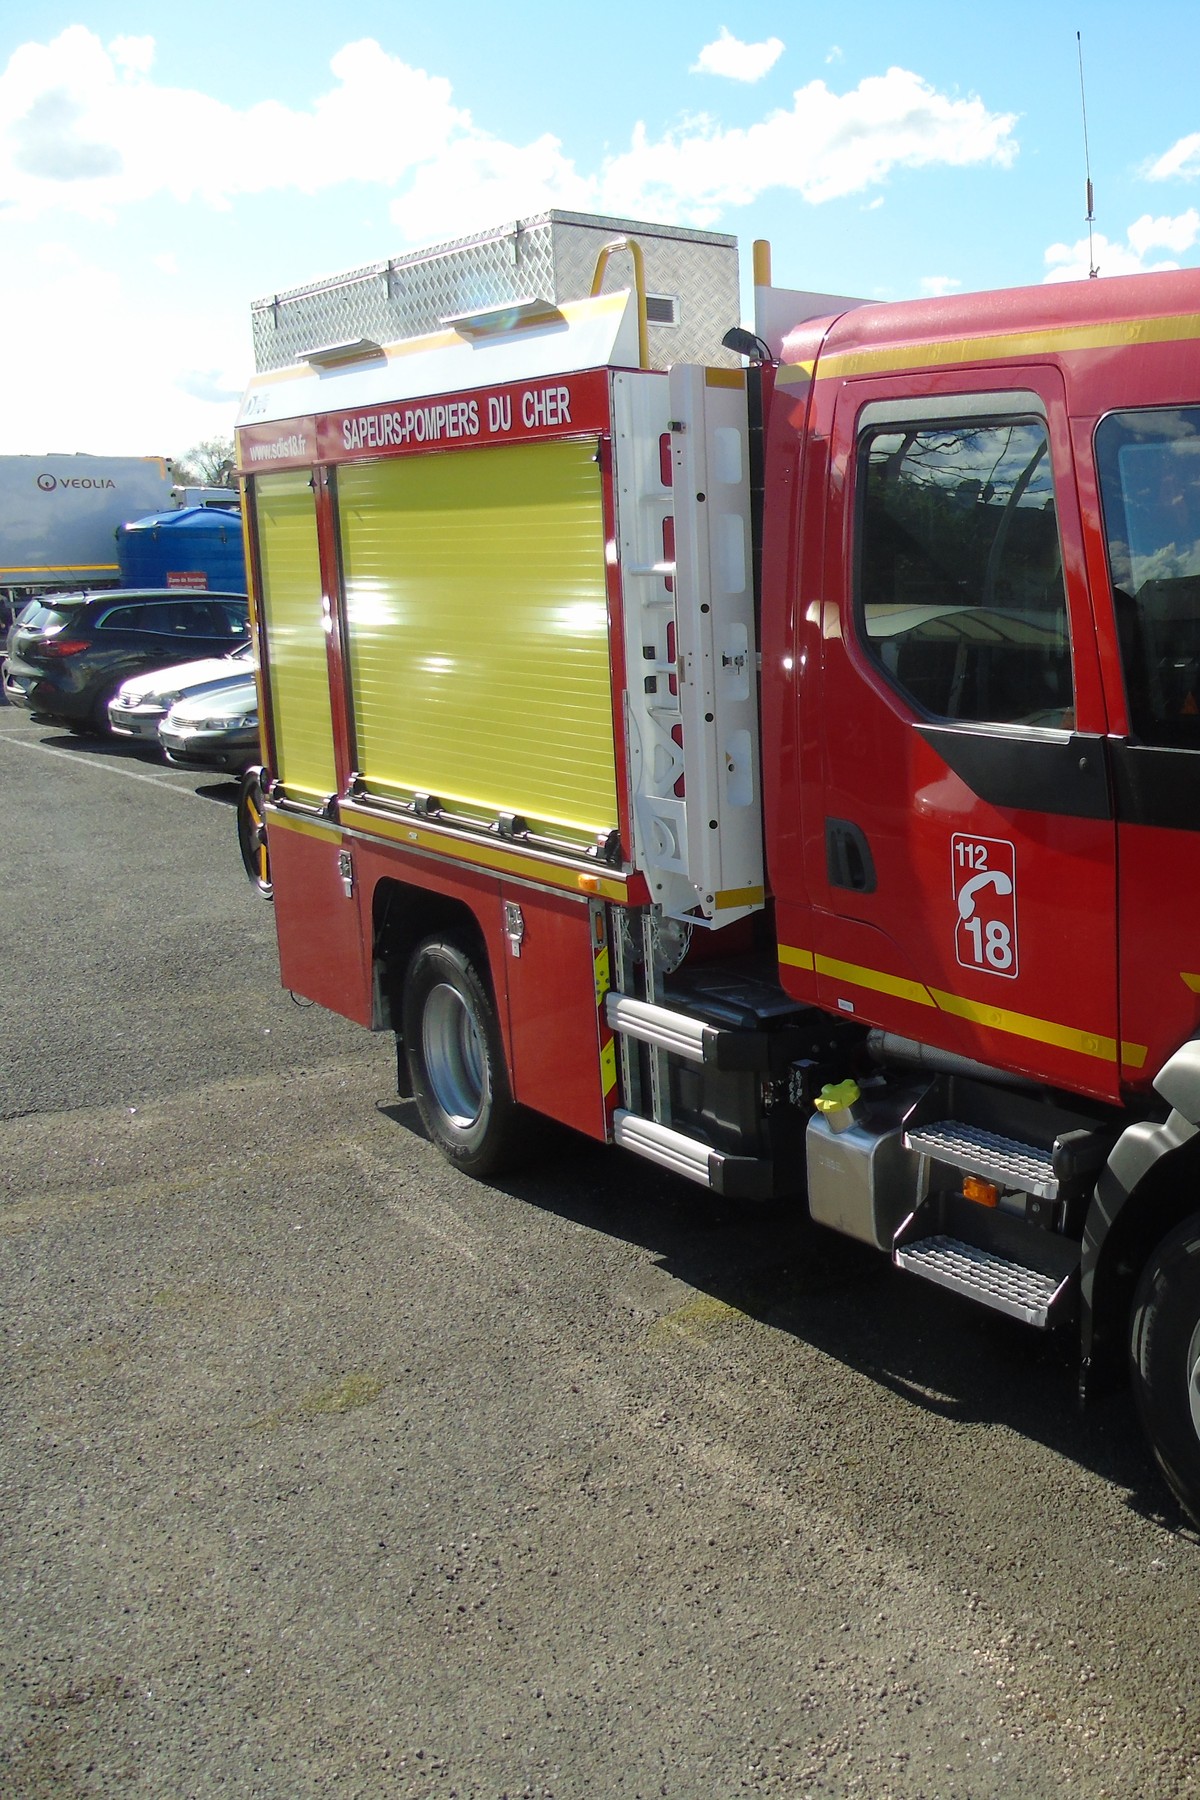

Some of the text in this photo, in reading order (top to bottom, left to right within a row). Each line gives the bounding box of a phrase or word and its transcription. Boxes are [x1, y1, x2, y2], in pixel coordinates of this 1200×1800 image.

[342, 386, 572, 450] SAPEURS-POMPIERS DU CHER
[249, 434, 306, 461] www.sdis18.fr
[60, 478, 116, 489] VEOLIA
[955, 841, 988, 871] 112
[964, 916, 1012, 969] 18
